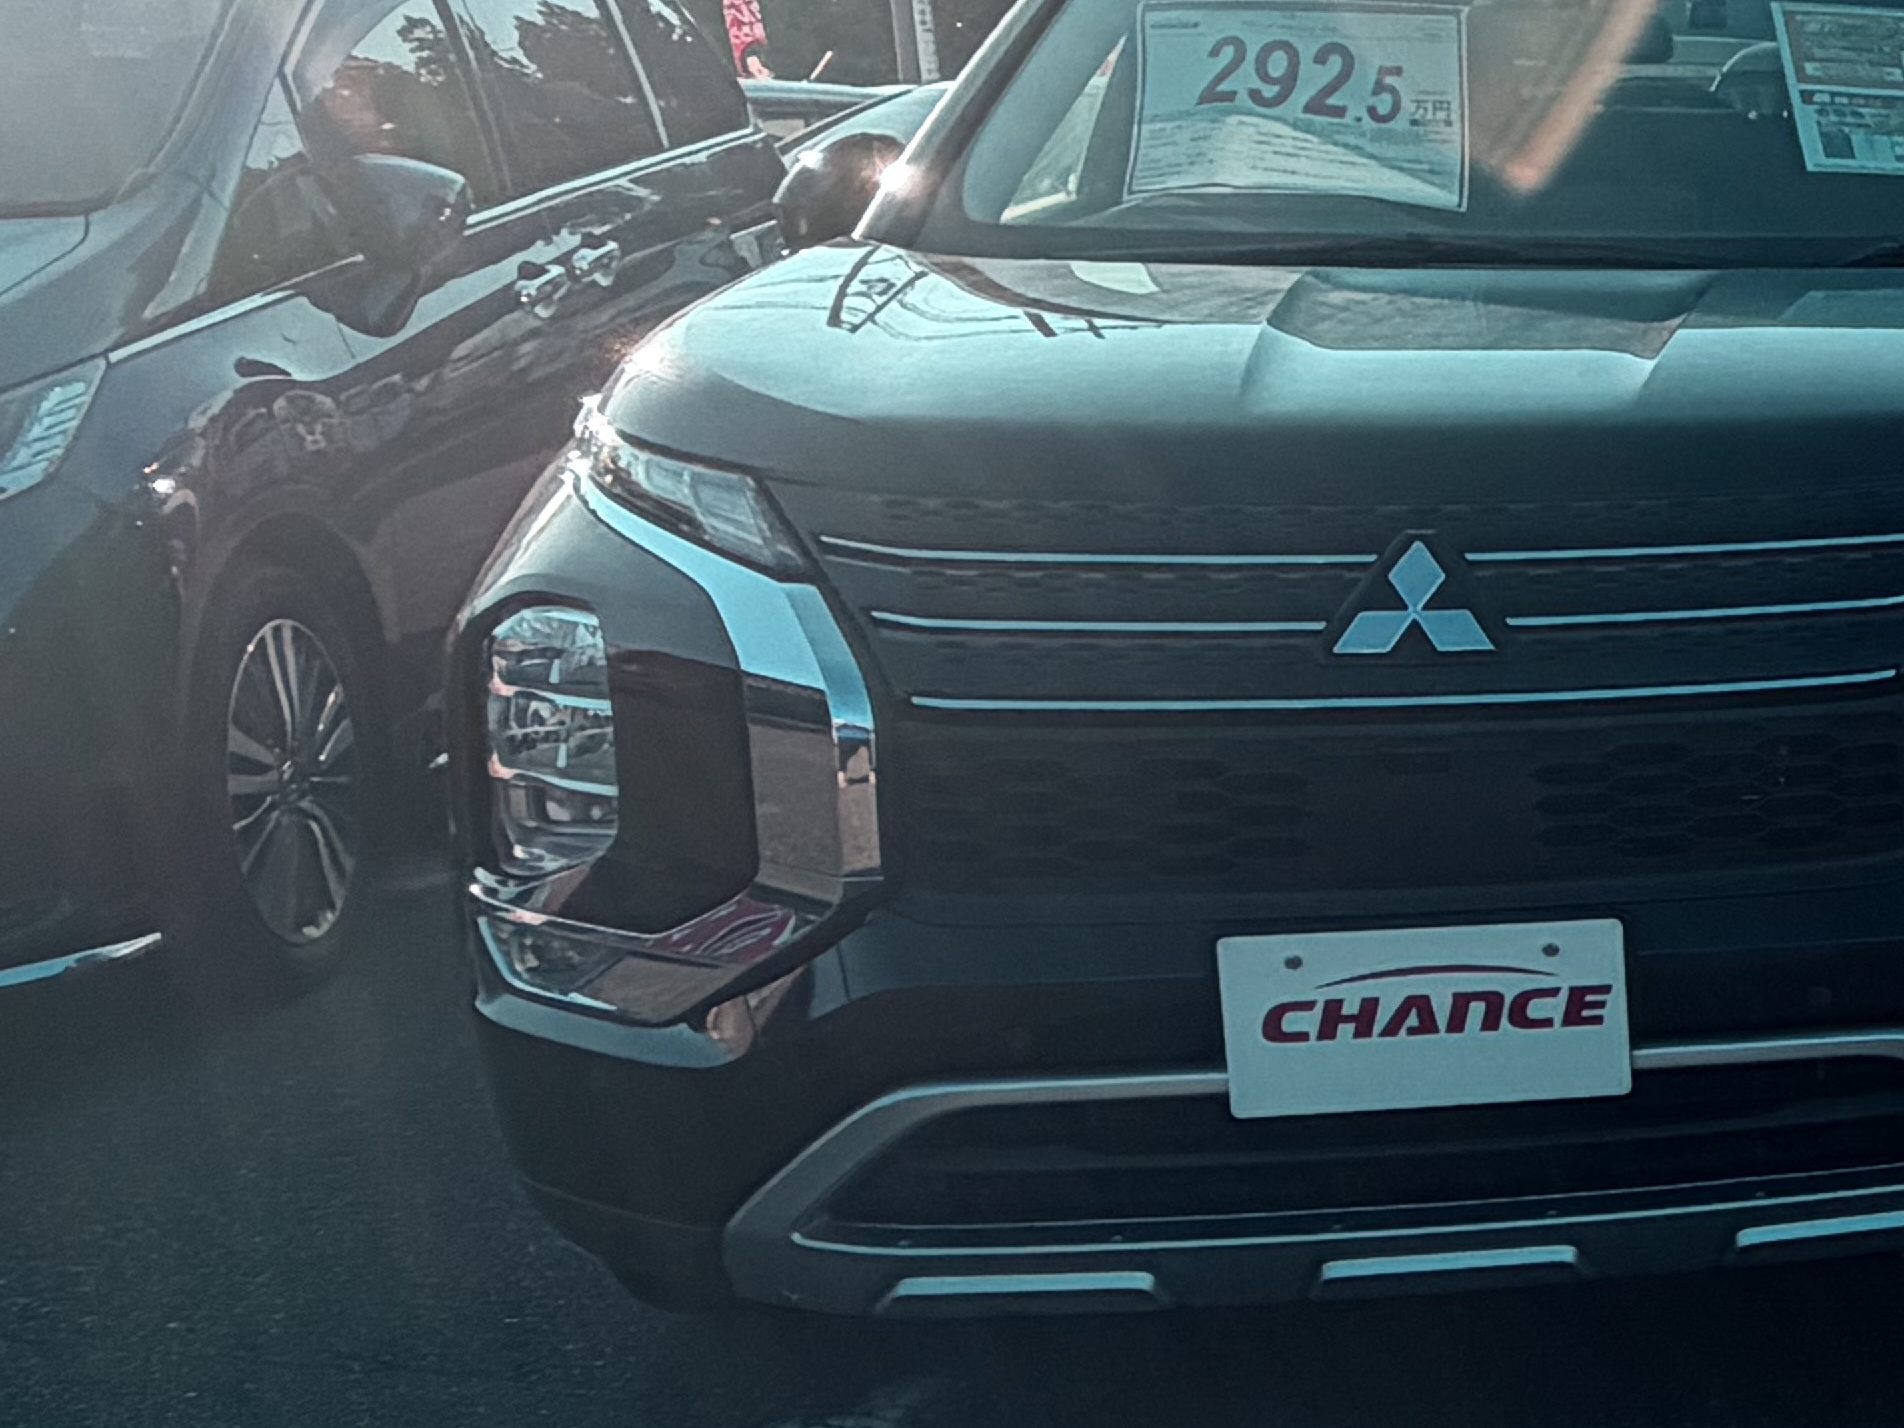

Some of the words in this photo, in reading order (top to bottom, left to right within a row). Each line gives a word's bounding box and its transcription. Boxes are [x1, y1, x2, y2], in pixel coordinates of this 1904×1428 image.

[1195, 36, 1403, 123] 292.5
[1410, 99, 1451, 119] 万円
[1262, 984, 1612, 1043] CHANCE
